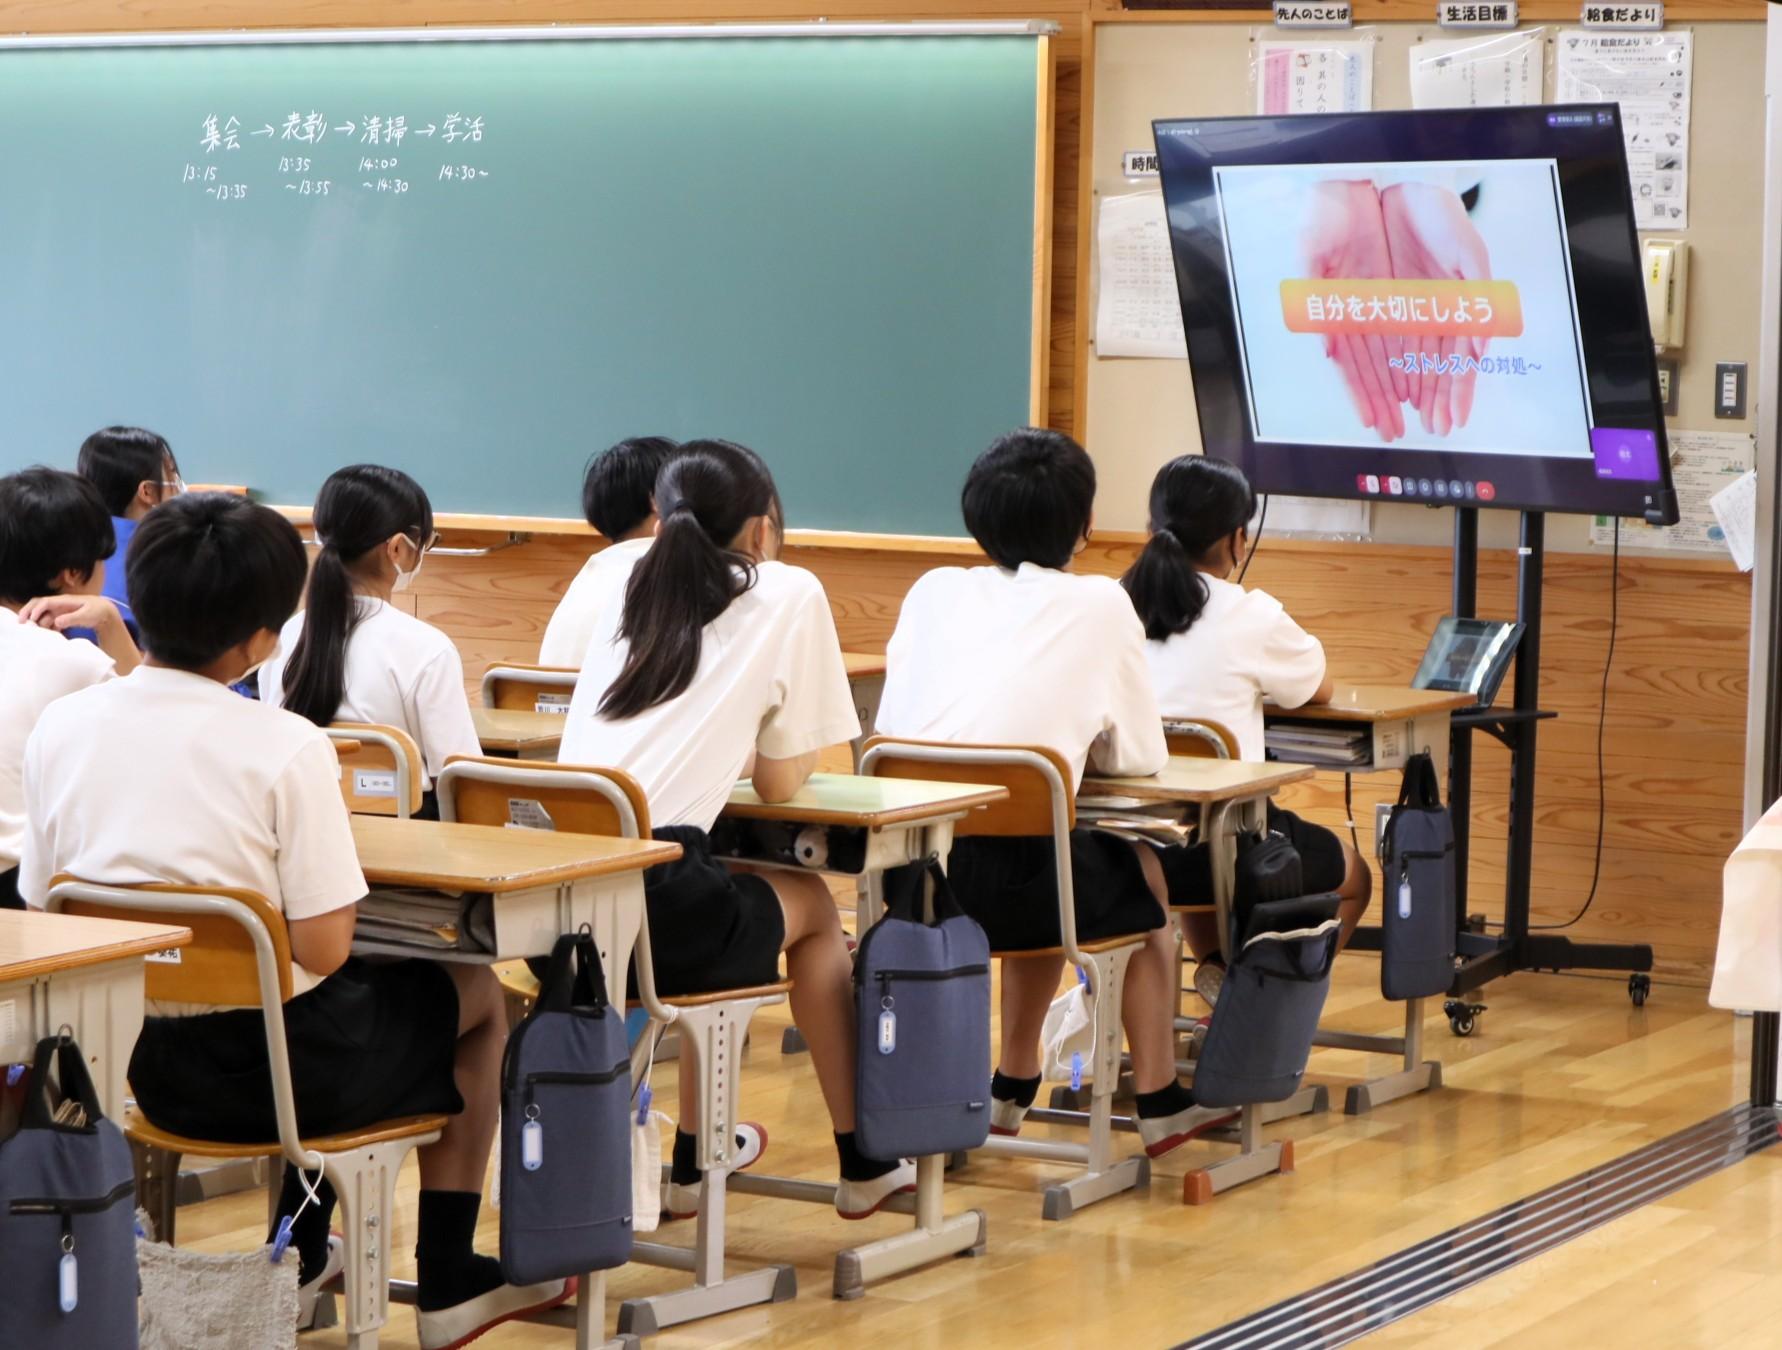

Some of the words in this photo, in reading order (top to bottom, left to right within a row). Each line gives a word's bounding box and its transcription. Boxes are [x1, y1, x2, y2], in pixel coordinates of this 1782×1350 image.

[1278, 8, 1349, 20] 先人のことば
[1447, 5, 1508, 21] 生活目標
[1587, 8, 1655, 22] 給食だより
[1600, 39, 1640, 47] 給食だより
[201, 113, 241, 152] 集会
[281, 110, 327, 143] 表彰
[361, 114, 408, 147] 清掃
[441, 111, 485, 142] 学活
[278, 155, 311, 172] 13:35
[358, 157, 398, 172] 14:00
[183, 163, 217, 182] 13:15
[1306, 294, 1493, 323] 自分を大切にしよう
